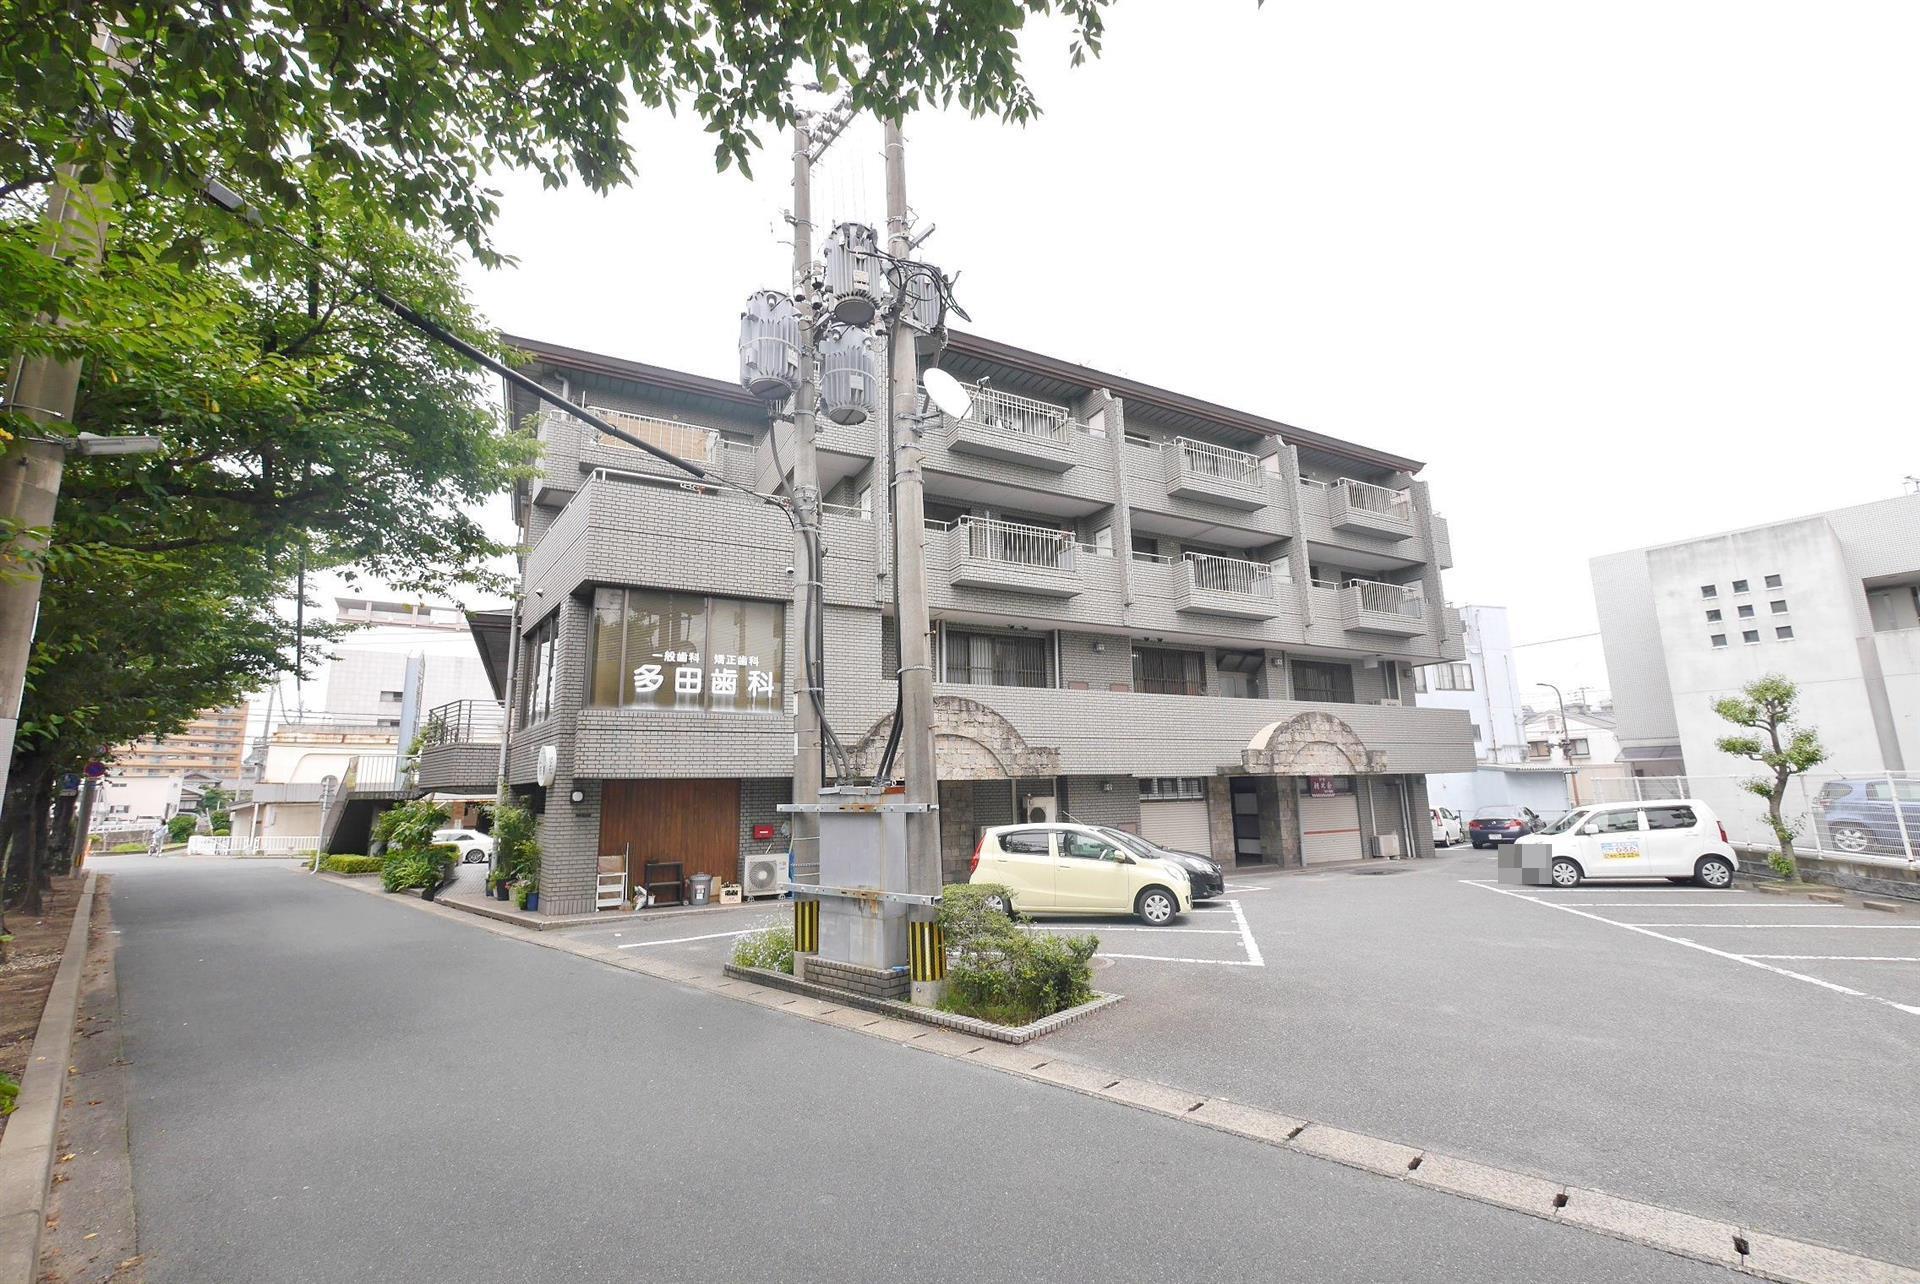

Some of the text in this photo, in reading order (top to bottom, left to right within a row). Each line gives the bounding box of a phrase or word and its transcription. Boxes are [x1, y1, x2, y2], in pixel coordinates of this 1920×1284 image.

[652, 650, 700, 663] 一般歯科
[714, 654, 759, 666] 矯正歯科
[634, 664, 774, 697] 多田歯科
